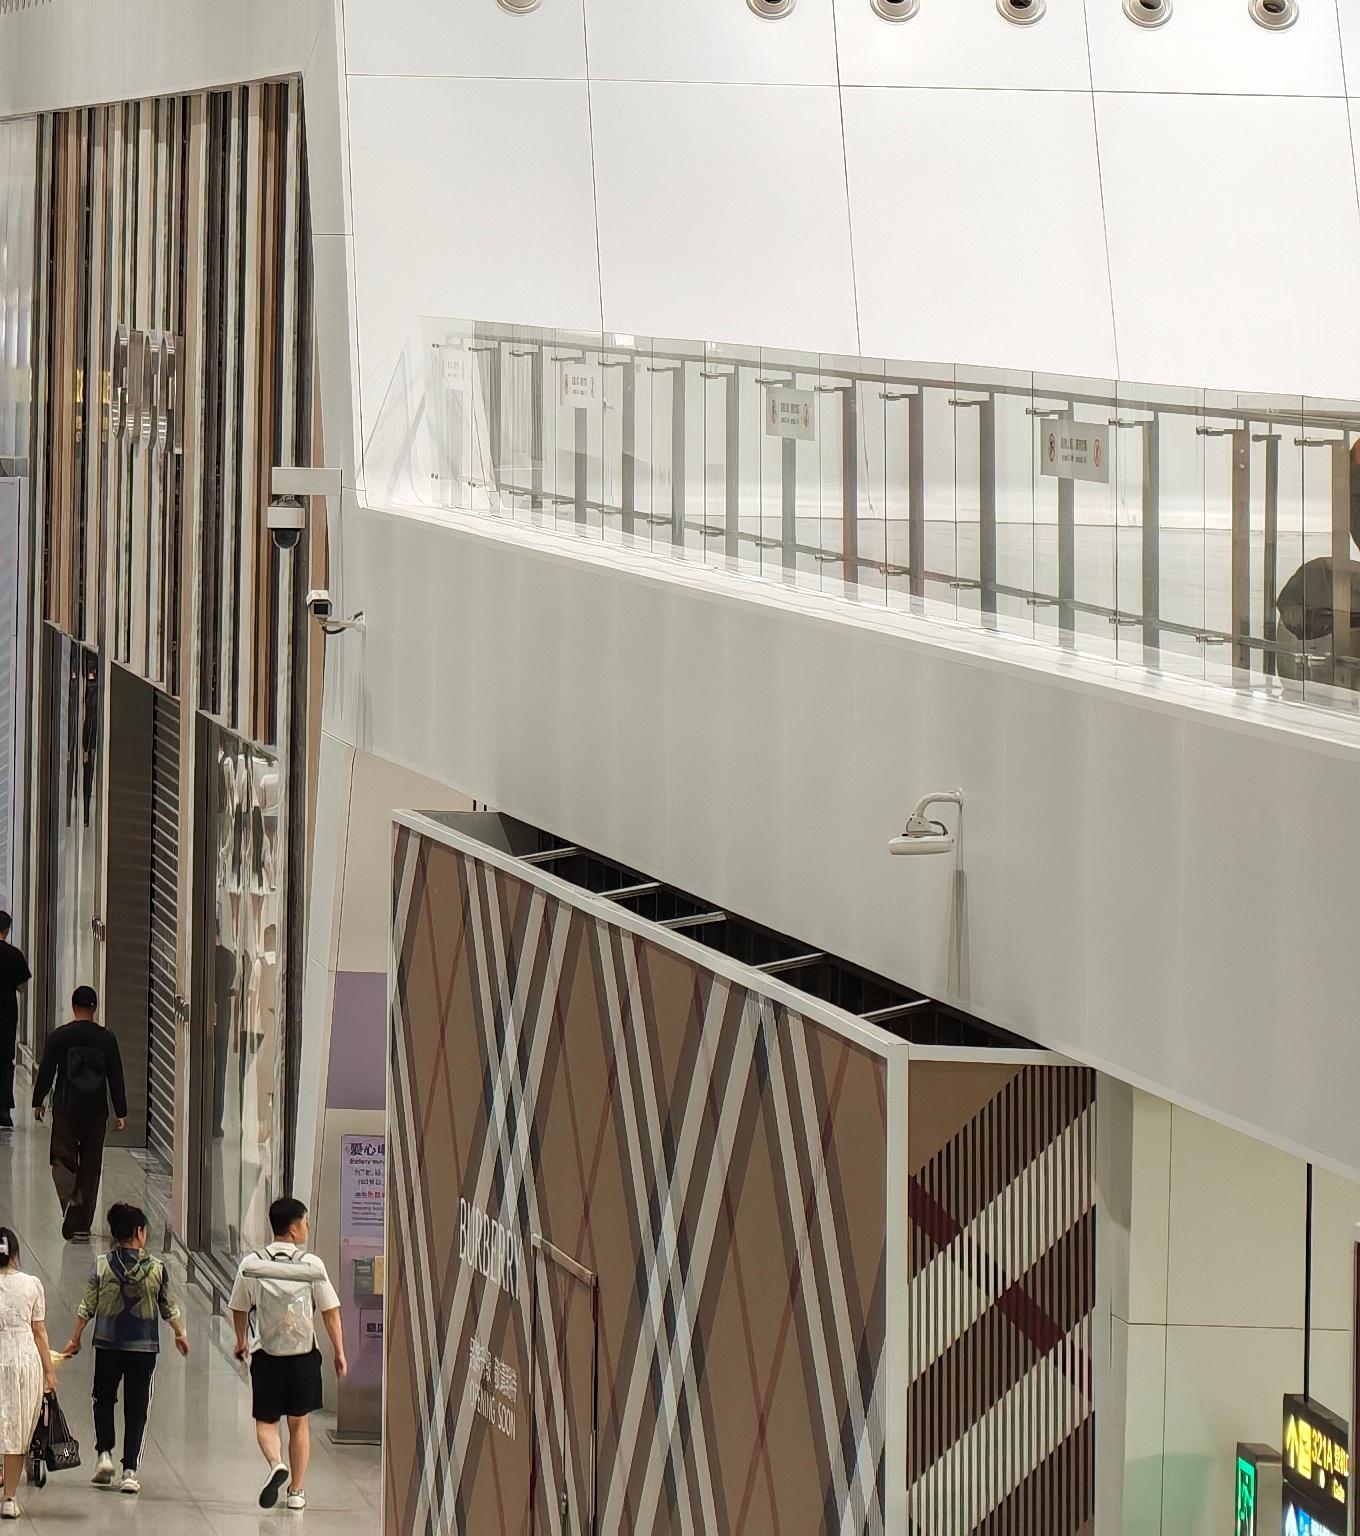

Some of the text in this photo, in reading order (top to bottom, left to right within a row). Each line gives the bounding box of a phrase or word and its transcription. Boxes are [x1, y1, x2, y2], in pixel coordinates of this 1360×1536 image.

[459, 1197, 521, 1301] BURBERRY
[498, 1402, 517, 1441] SOON
[1311, 1427, 1334, 1475] 321A
